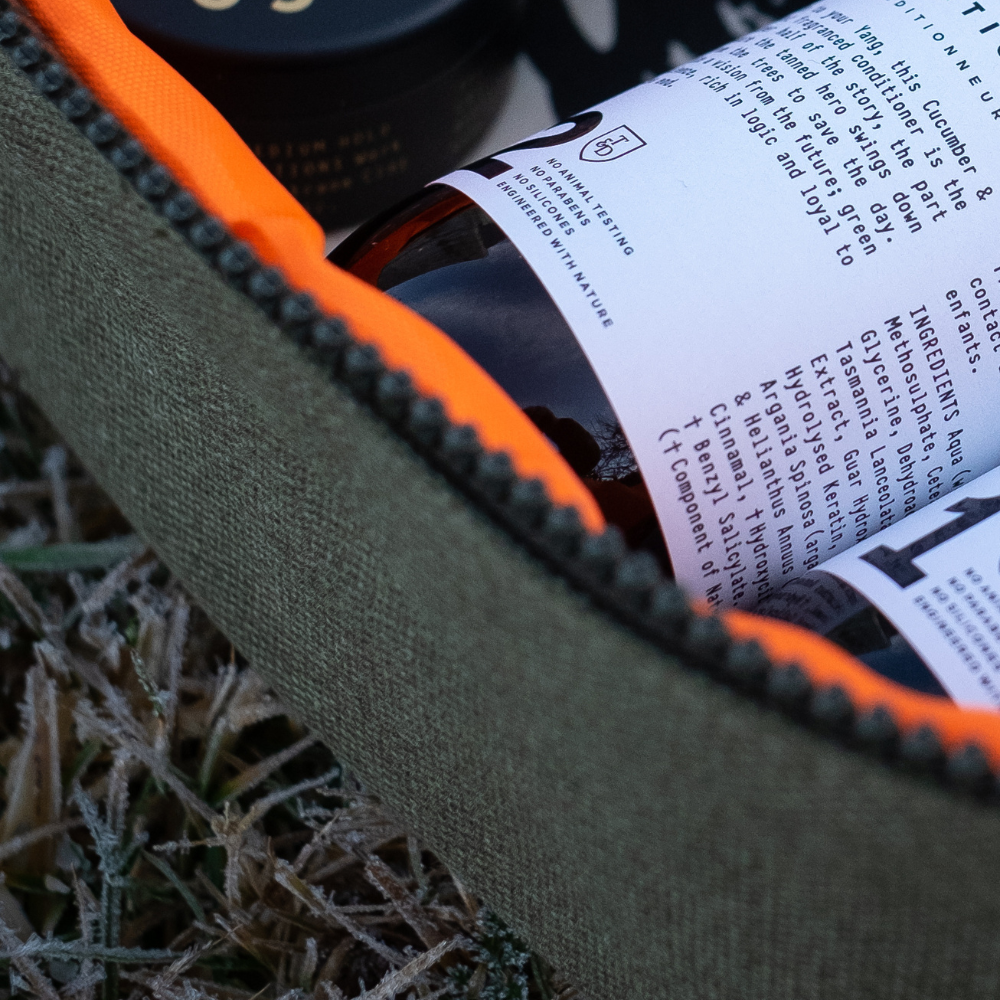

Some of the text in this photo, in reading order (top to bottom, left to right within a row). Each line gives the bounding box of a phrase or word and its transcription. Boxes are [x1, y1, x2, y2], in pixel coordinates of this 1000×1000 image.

[724, 92, 743, 107] in
[741, 108, 777, 146] logic
[777, 152, 806, 179] and
[800, 185, 840, 235] loyal
[836, 244, 854, 266] to
[745, 80, 775, 106] from
[772, 106, 796, 130] the
[795, 134, 842, 197] future;
[837, 204, 876, 255] green
[751, 57, 895, 243] trees to save the day.
[776, 48, 922, 233] tanned hero swings down
[802, 42, 947, 222] of the story, the part
[851, 55, 924, 134] conditioner
[924, 148, 943, 168] is
[944, 179, 967, 211] the
[854, 25, 993, 201] Yang, this Cucumber &
[496, 181, 613, 327] ENGINEERED WITH NATURE
[513, 173, 575, 236] NO SILICONES
[530, 166, 591, 226] NO PARABENS
[546, 158, 634, 256] NO ANIMAL TESTING
[836, 340, 877, 440] Tasmannia
[861, 330, 902, 437] Glycerine,
[884, 315, 937, 462] Methosulphate,
[909, 304, 960, 422] INGREDIENTS
[946, 429, 963, 466] Aqua
[946, 290, 981, 373] enfants.
[693, 438, 729, 505] Benzyl
[710, 403, 753, 502] Cinnamal,
[734, 391, 751, 407] &
[744, 413, 786, 518] Helianthus
[777, 525, 794, 575] Annuus
[759, 379, 815, 529] Argania Spinosa
[784, 365, 843, 550] Hydrolysed Keratin,
[810, 353, 848, 442] Extract,
[843, 449, 862, 487] Guar
